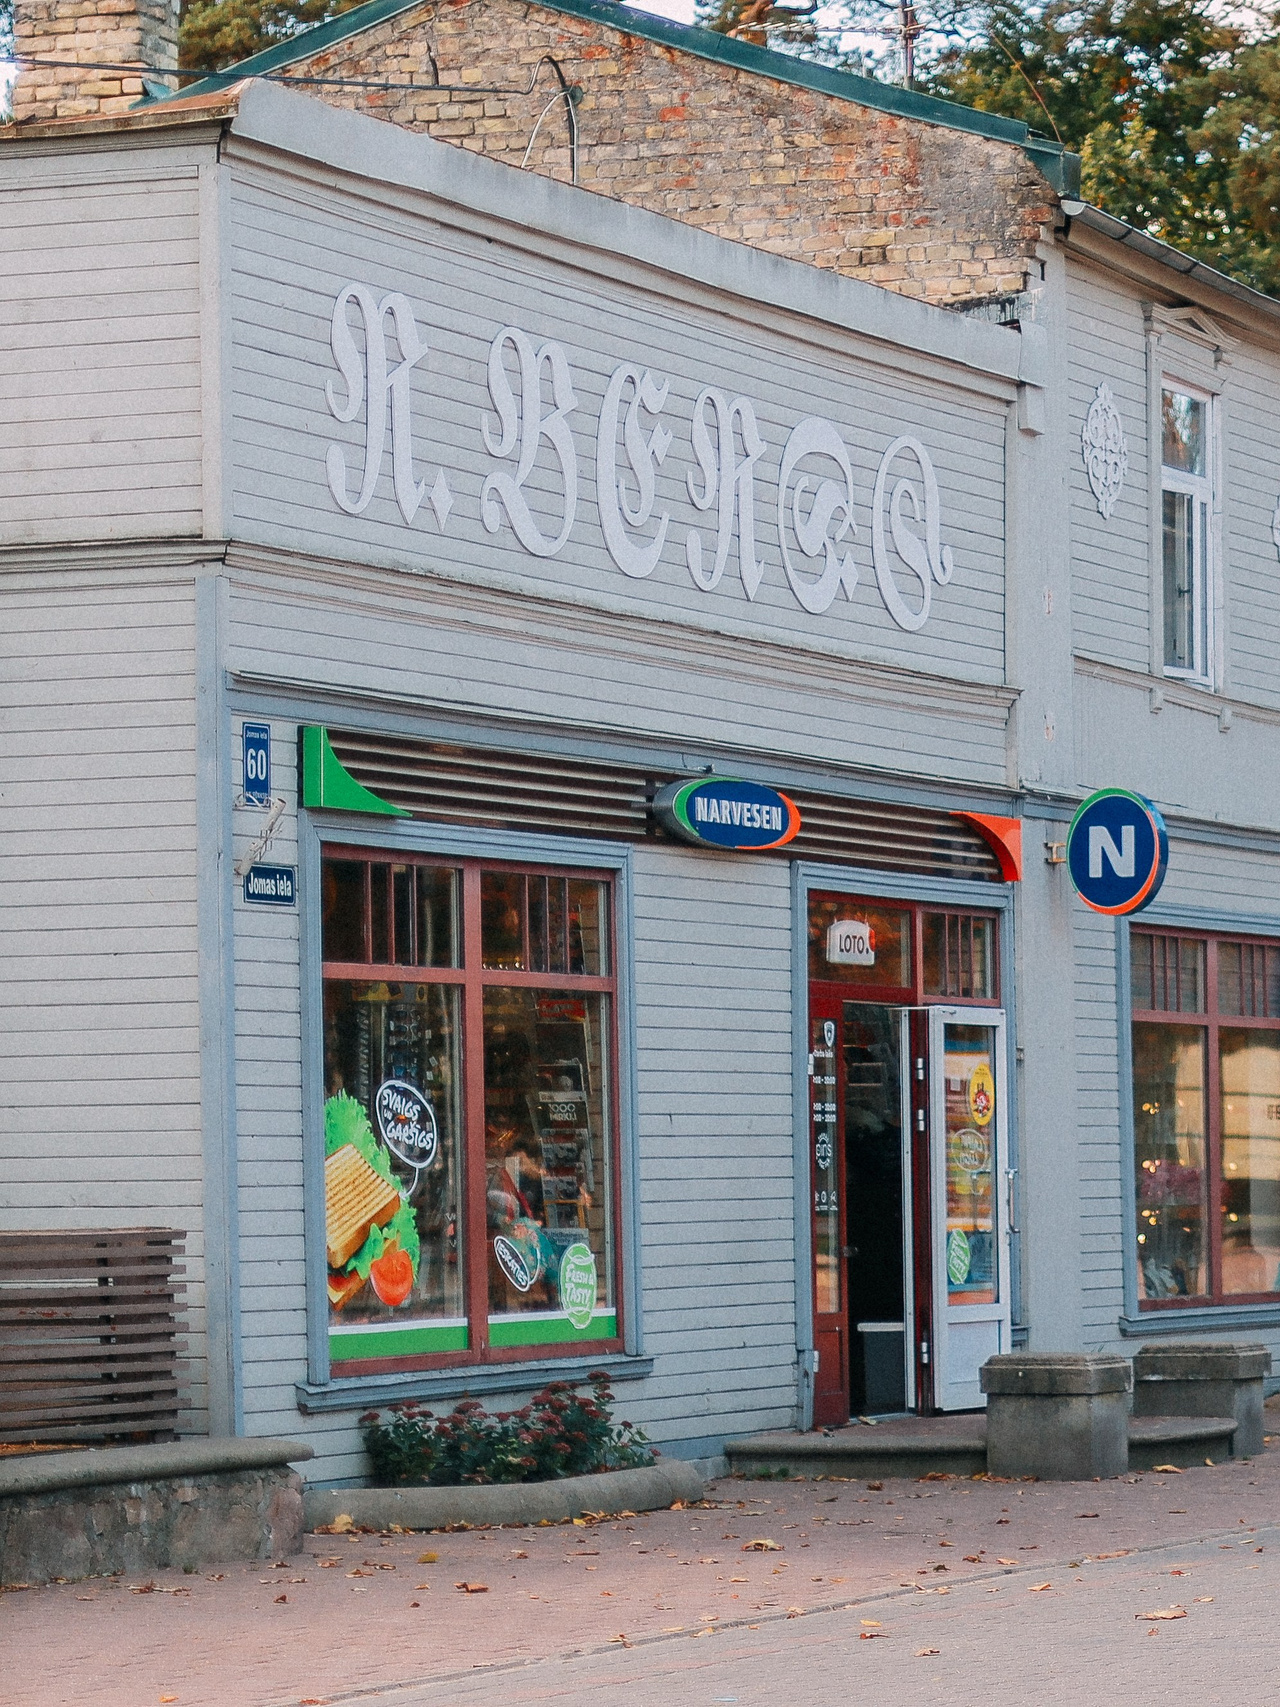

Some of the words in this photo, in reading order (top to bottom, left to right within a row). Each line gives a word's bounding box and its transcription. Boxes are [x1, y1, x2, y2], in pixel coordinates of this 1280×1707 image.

[247, 748, 267, 780] 60
[695, 796, 782, 831] NARVESEN
[1088, 825, 1135, 878] N
[248, 873, 275, 895] Jomas
[276, 874, 292, 897] iela
[383, 1088, 420, 1121] SVAIGS
[387, 1121, 433, 1150] GARŠĪGS
[565, 1282, 591, 1308] TASTY
